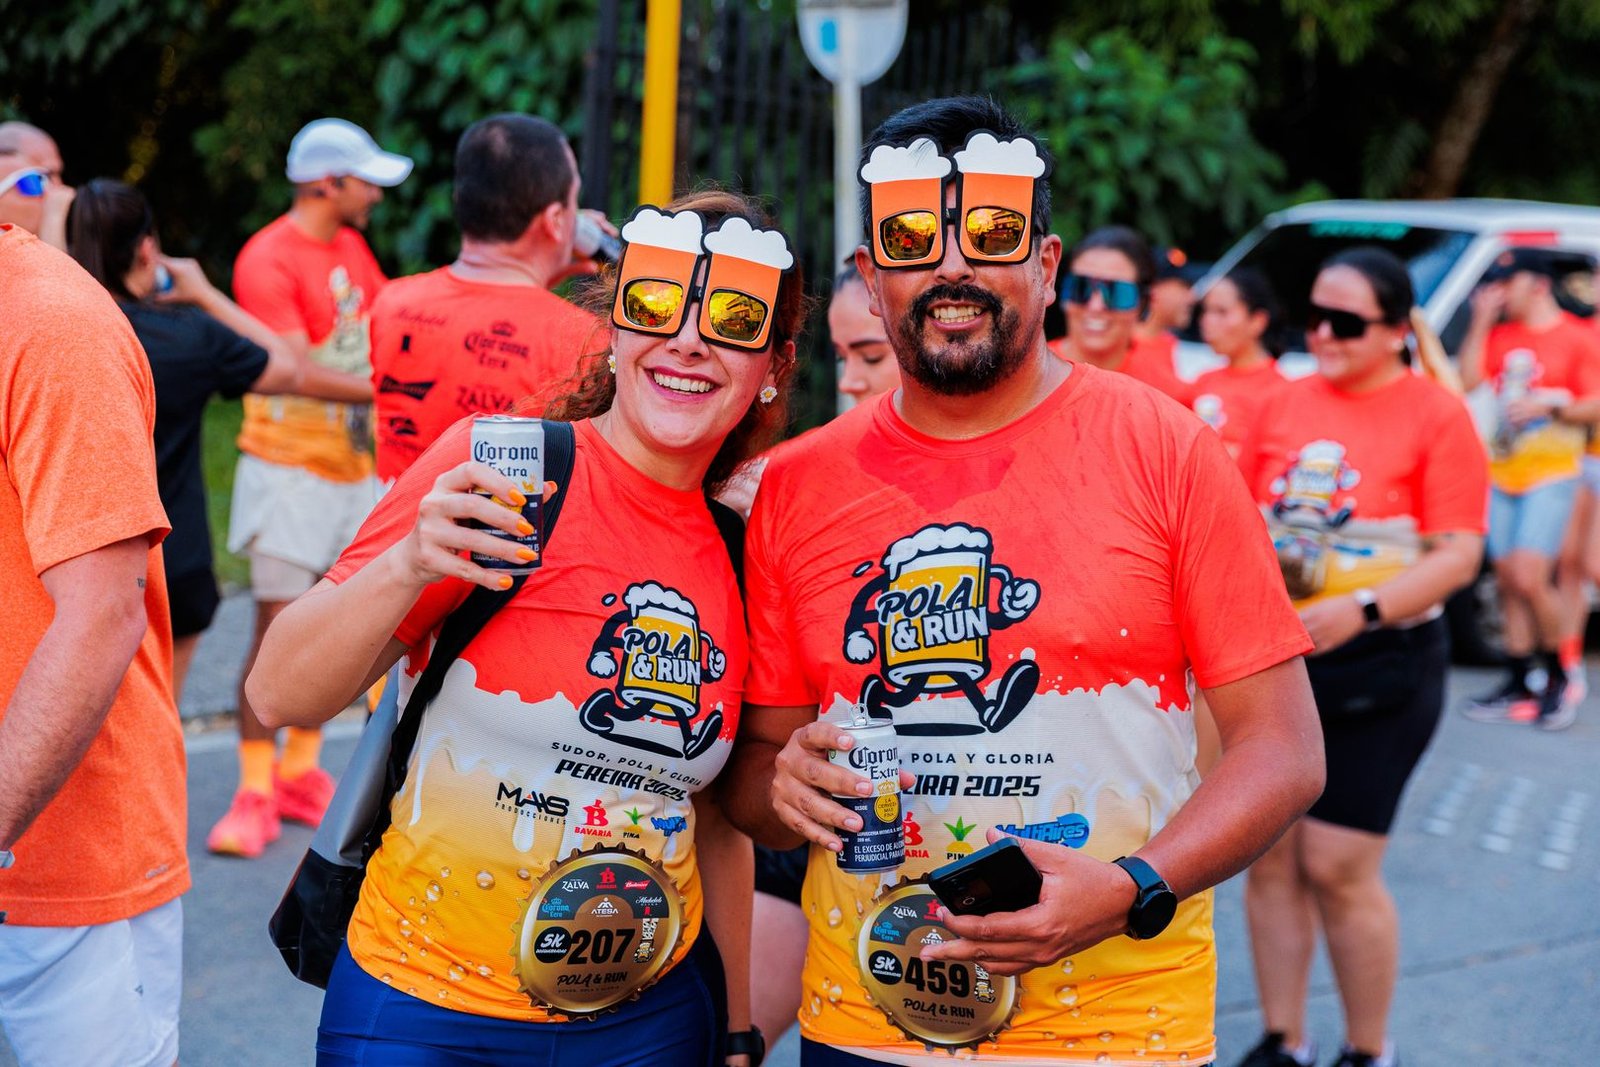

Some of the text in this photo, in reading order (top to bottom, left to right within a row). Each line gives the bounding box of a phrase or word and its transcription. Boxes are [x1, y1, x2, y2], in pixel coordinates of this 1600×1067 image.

[474, 440, 540, 463] Corona
[876, 575, 974, 624] POLA
[893, 605, 990, 652] & RUN
[623, 628, 691, 660] POLA
[632, 654, 701, 685] & RUN
[551, 742, 703, 787] SUDOR, POLA Y GLORIA
[848, 746, 898, 771] Coron
[911, 753, 1055, 765] POLA Y GLORIA
[555, 758, 689, 802] PEREIRA 2025
[963, 775, 1042, 798] 2025
[494, 801, 566, 825] PRODUCCIONES
[574, 826, 613, 838] BAVARIA
[854, 845, 861, 854] EL
[862, 844, 885, 854] EXCESO
[885, 843, 893, 852] DE
[855, 852, 888, 862] PERJUDICIAL
[904, 850, 930, 858] ARIA
[946, 852, 966, 860] PIN
[561, 881, 590, 892] ZALVA
[893, 906, 918, 918] ZALVA
[567, 928, 636, 965] 207
[557, 971, 628, 987] POLA & RUN
[905, 956, 970, 998] 459
[903, 998, 975, 1019] POLA & RUN
